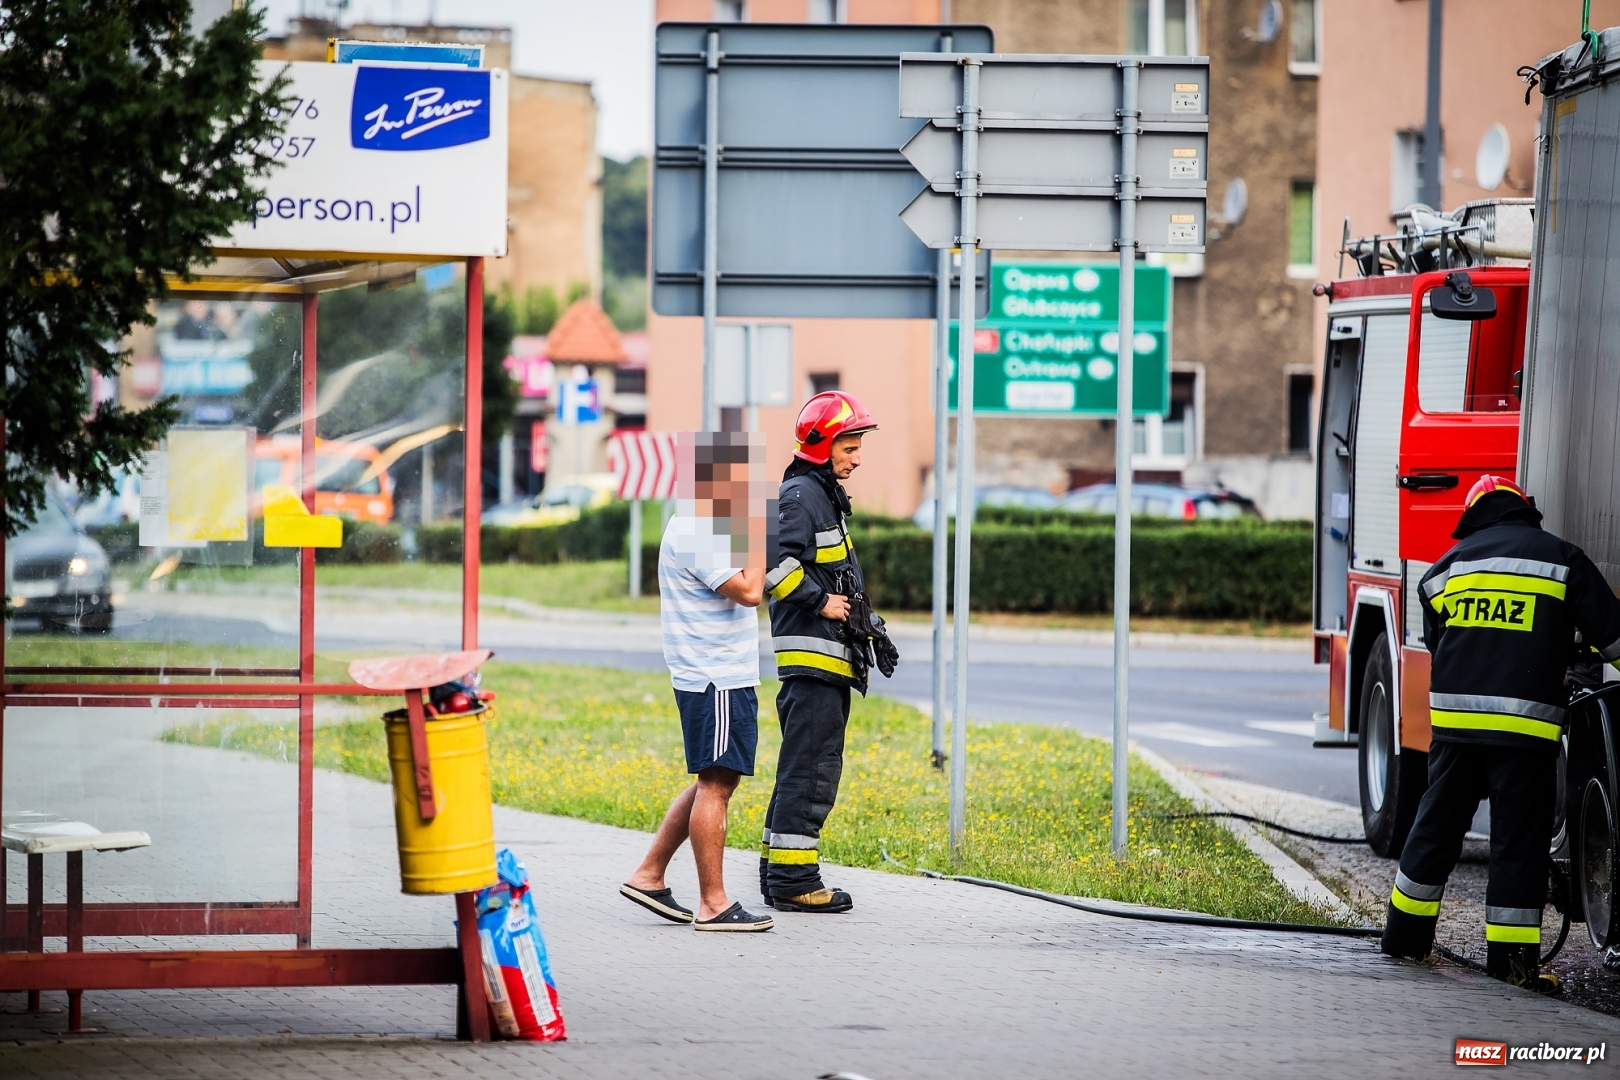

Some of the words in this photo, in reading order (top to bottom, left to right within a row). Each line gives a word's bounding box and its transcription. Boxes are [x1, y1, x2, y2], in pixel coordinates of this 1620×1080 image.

[403, 87, 482, 124] Person
[270, 136, 316, 158] 957
[251, 185, 421, 234] person.pl
